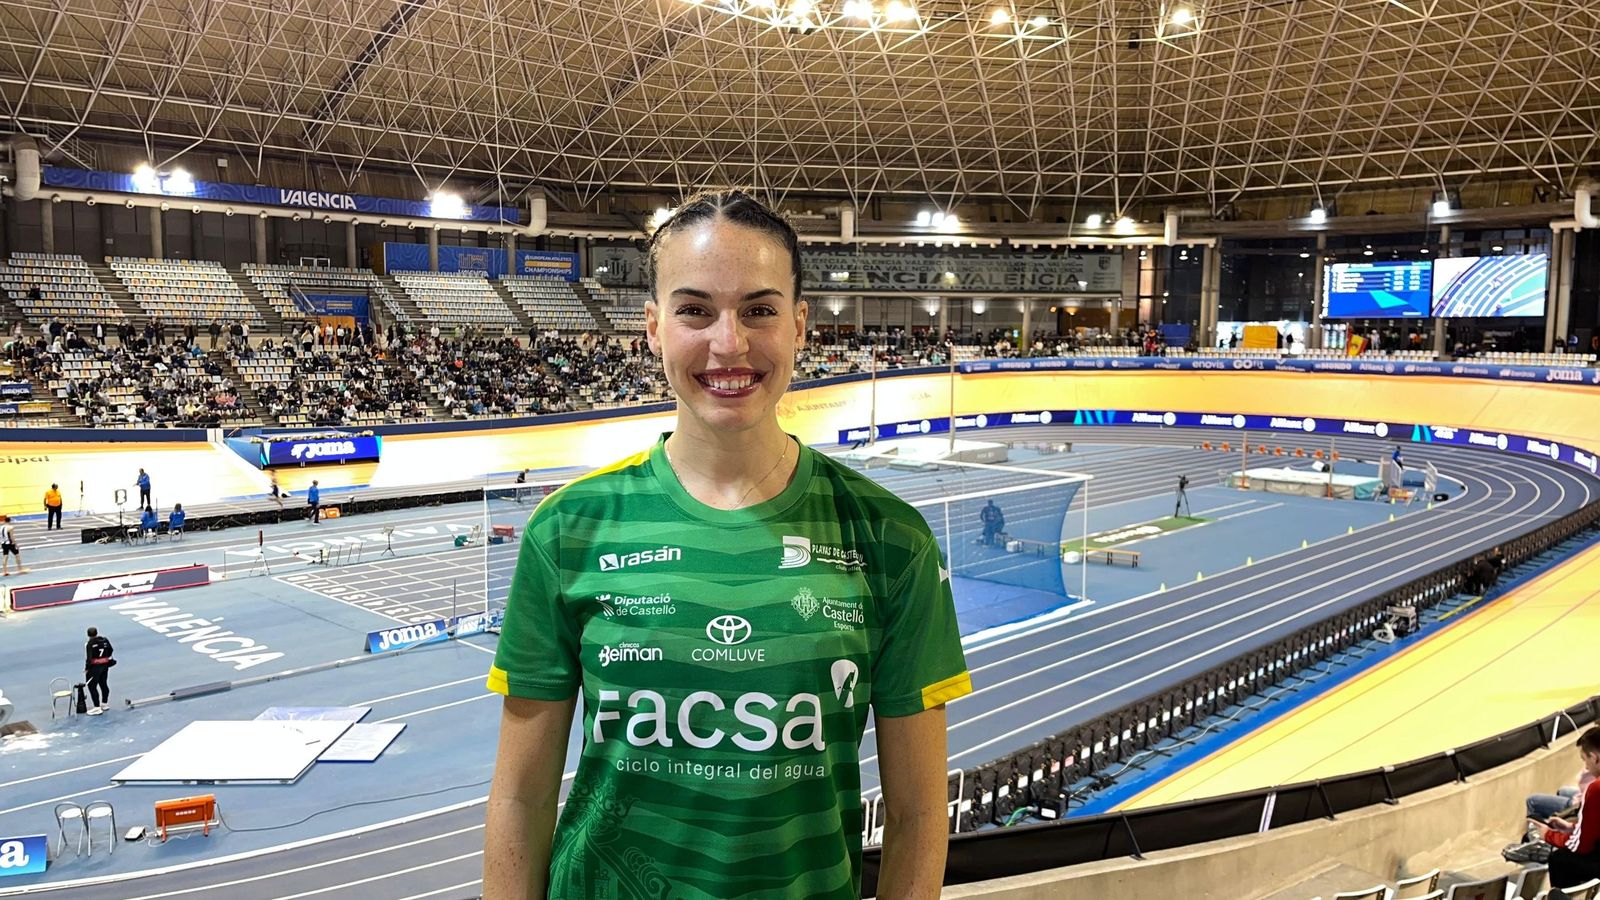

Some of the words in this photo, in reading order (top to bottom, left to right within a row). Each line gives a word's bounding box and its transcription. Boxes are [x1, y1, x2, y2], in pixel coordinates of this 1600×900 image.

[280, 189, 357, 210] VALENCIA
[956, 272, 1080, 286] VALENCIA
[1192, 360, 1225, 369] enovis
[620, 545, 682, 569] rasán
[811, 544, 832, 556] PLAYAS
[832, 547, 841, 558] DE
[614, 592, 671, 607] Diputació
[822, 596, 858, 609] Ajuntament
[616, 606, 628, 617] de
[629, 603, 677, 616] Castelló
[822, 605, 864, 624] Castelló
[833, 620, 855, 632] Esports
[379, 622, 438, 650] Joma
[691, 648, 765, 662] COMLUVE
[616, 758, 660, 773] ciclo
[667, 759, 741, 781] integral
[749, 764, 778, 780] del
[784, 764, 825, 781] agua
